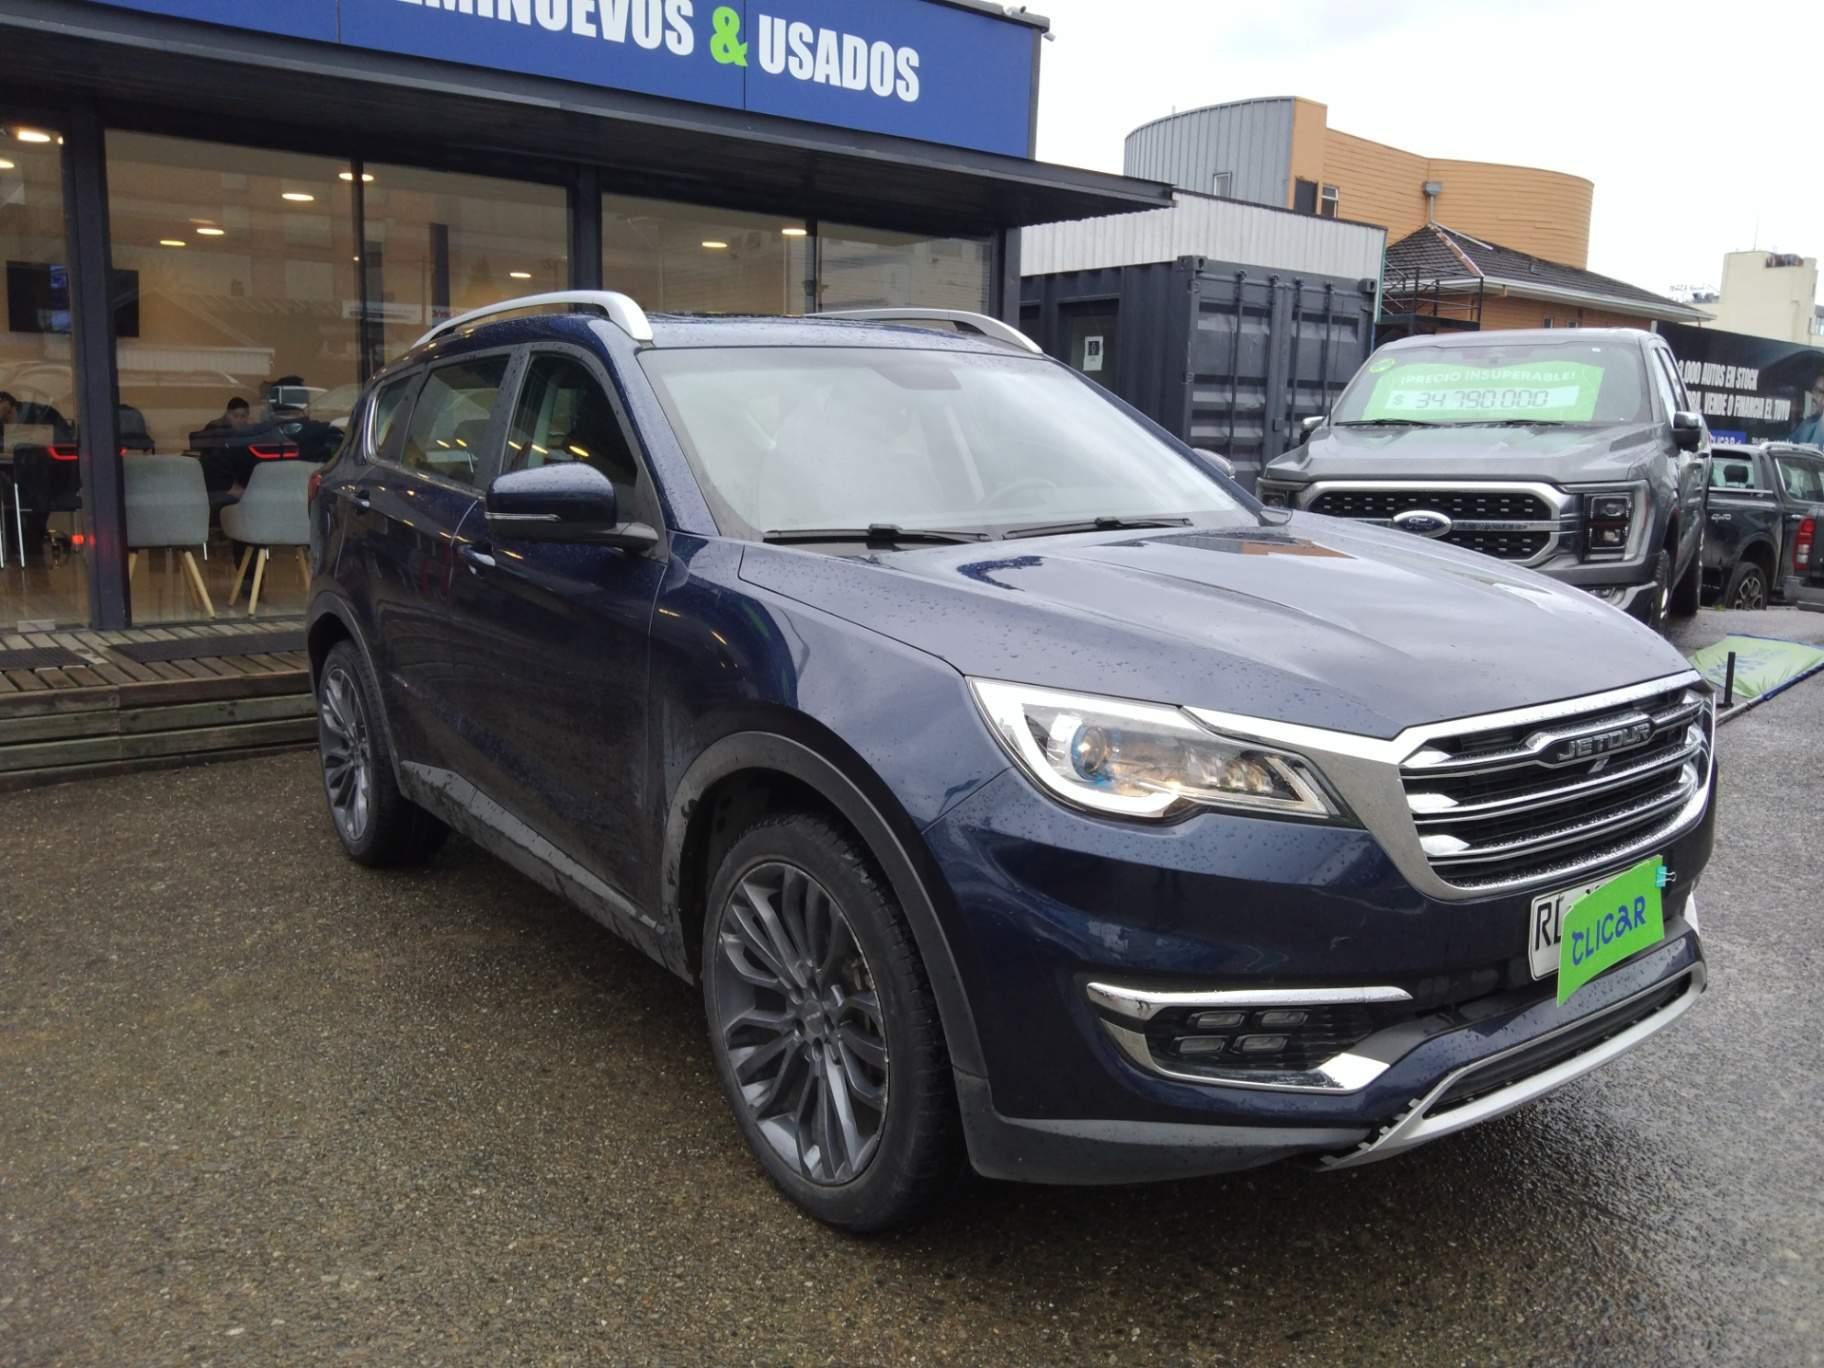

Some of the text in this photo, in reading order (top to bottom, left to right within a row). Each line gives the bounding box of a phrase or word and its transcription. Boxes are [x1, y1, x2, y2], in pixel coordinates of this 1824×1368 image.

[395, 0, 921, 103] UEVOS & USADOS
[1701, 361, 1726, 387] AUTOS
[1725, 365, 1737, 389] EN
[1735, 366, 1759, 391] STOCK
[1557, 722, 1650, 761] JETOUR
